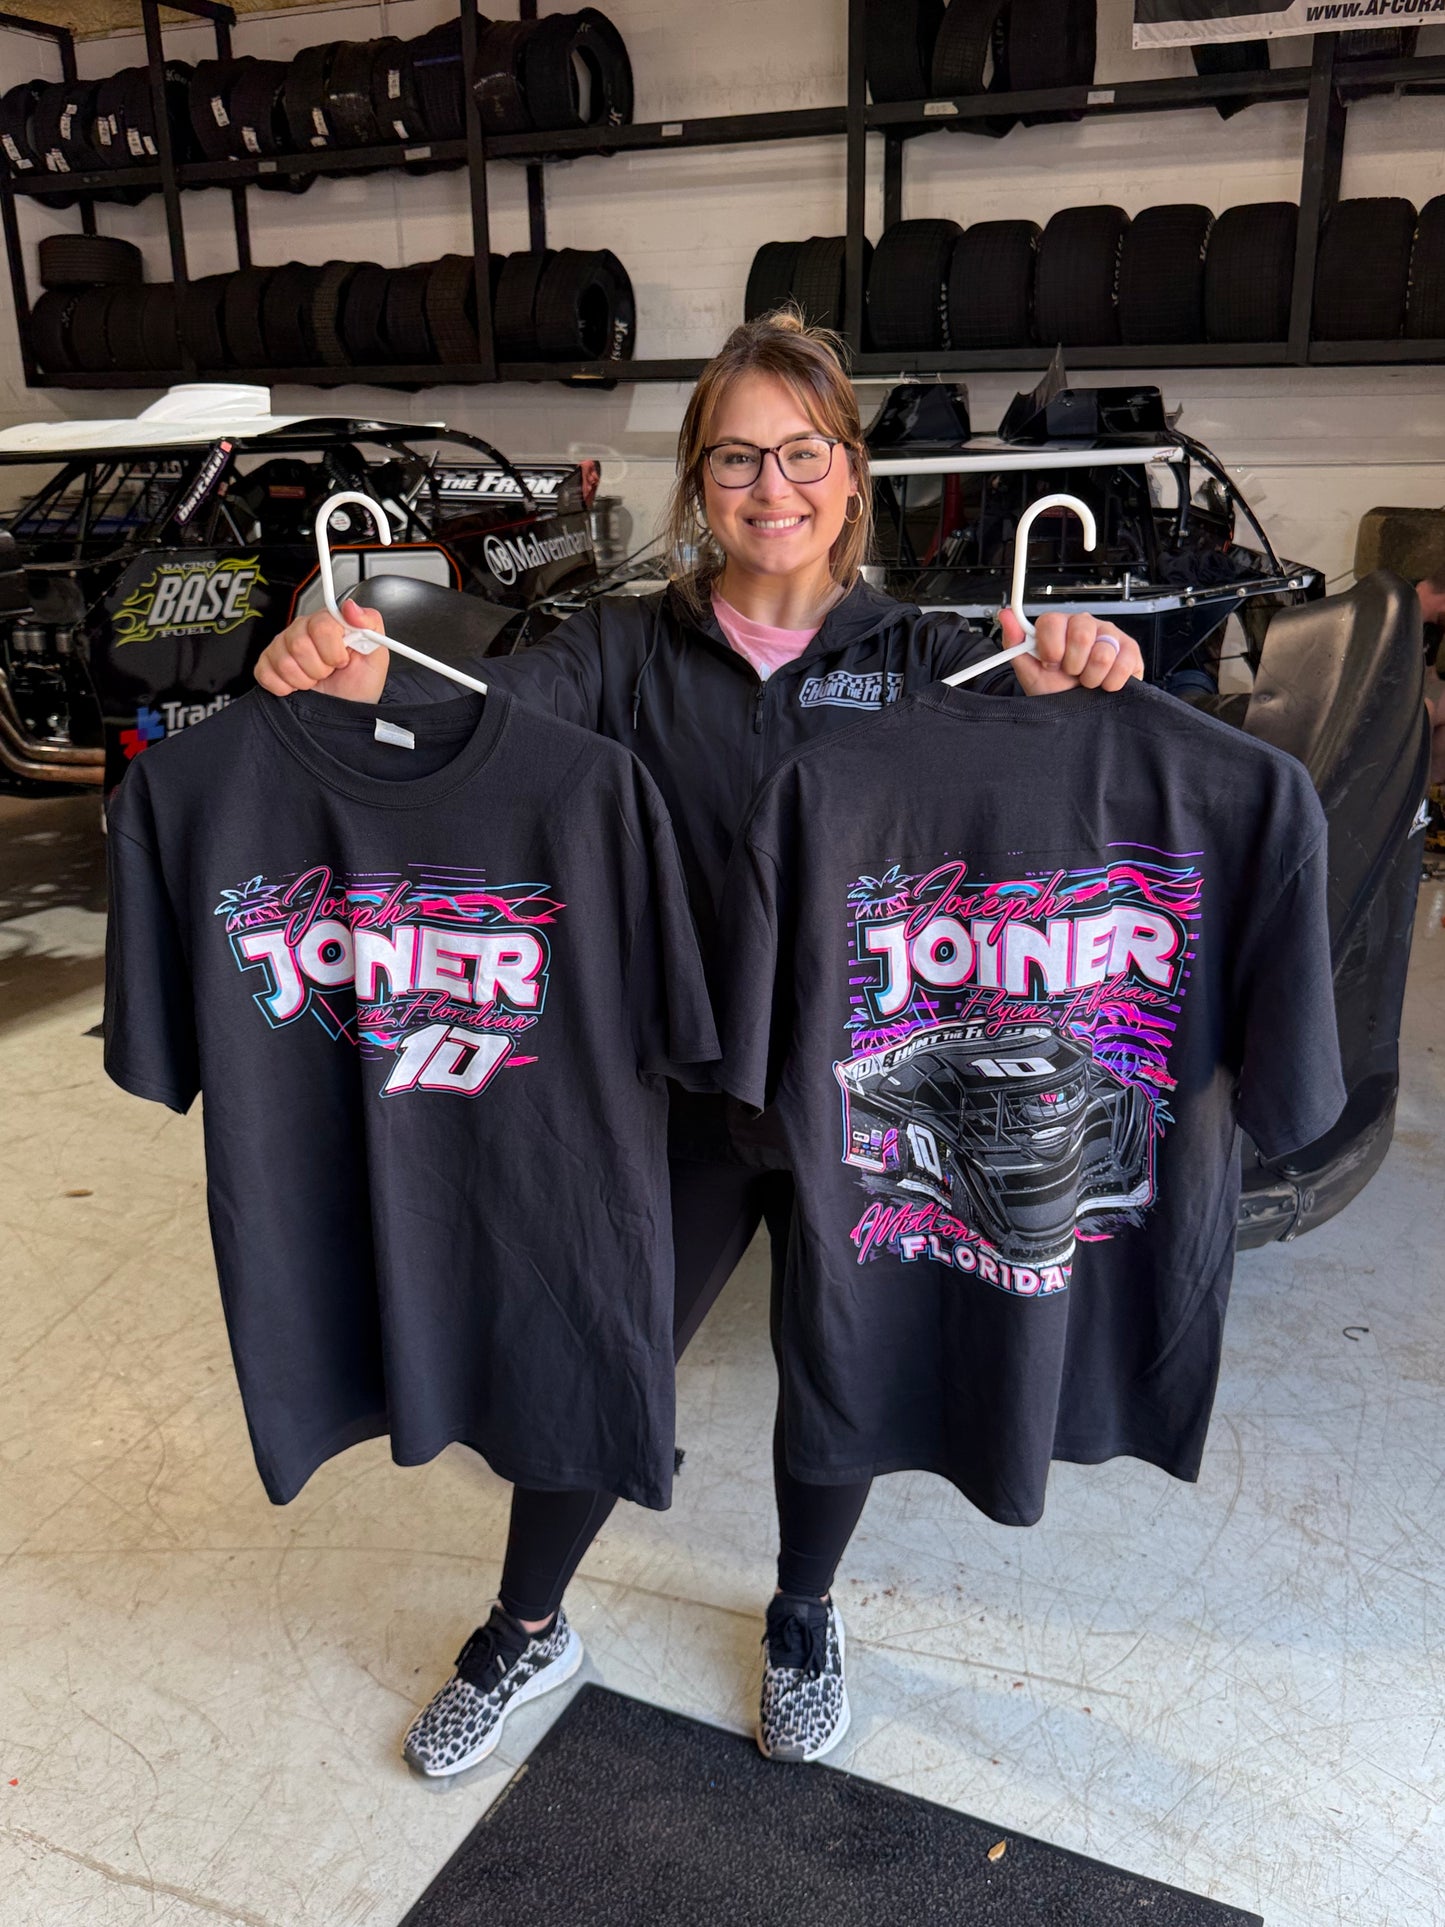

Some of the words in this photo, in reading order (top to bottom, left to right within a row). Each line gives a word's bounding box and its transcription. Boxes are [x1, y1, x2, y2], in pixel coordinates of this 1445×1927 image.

[441, 478, 479, 490] THE
[162, 561, 217, 571] RACING
[147, 571, 255, 626] BASE
[160, 626, 212, 638] FUEL
[808, 681, 847, 701] HUNT
[847, 686, 862, 699] THE
[903, 860, 1075, 947] Joseph
[242, 920, 543, 1021] JONER
[866, 904, 1179, 1015] JOINER
[400, 989, 538, 1031] Floridian
[381, 1023, 516, 1098] 10
[968, 1057, 1058, 1078] 10
[906, 1123, 943, 1181] 10
[900, 1233, 1067, 1295] FLORIDA
